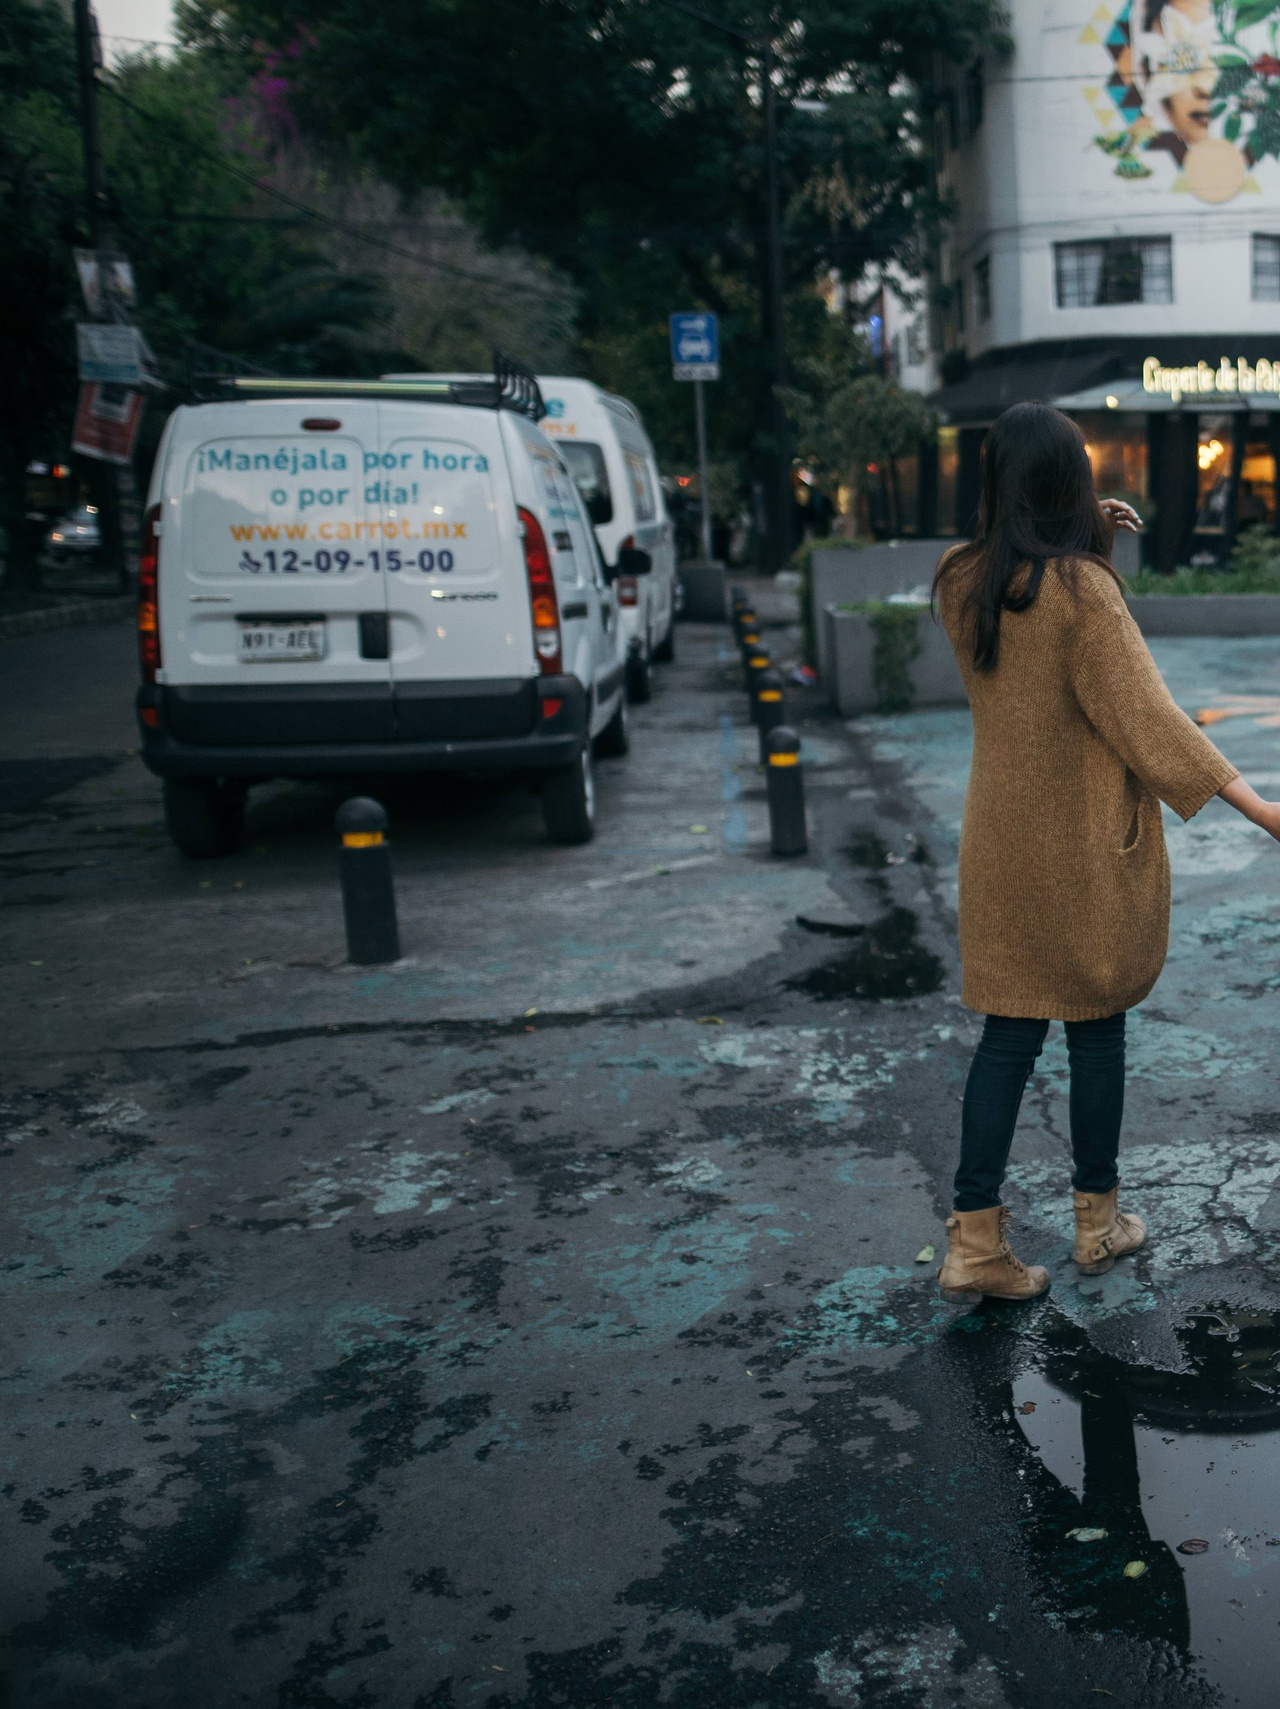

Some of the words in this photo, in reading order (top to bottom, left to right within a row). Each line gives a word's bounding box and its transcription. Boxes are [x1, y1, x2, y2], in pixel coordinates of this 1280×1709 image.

[1216, 355, 1238, 393] de
[1238, 355, 1257, 393] la
[197, 448, 348, 476] ¡Manéjala
[363, 450, 413, 473] por
[423, 449, 489, 473] hora
[270, 487, 288, 506] o
[299, 488, 349, 510] por
[364, 482, 419, 504] día!
[229, 519, 468, 541] www.carrot.mx
[264, 550, 455, 572] 12-09-15-00
